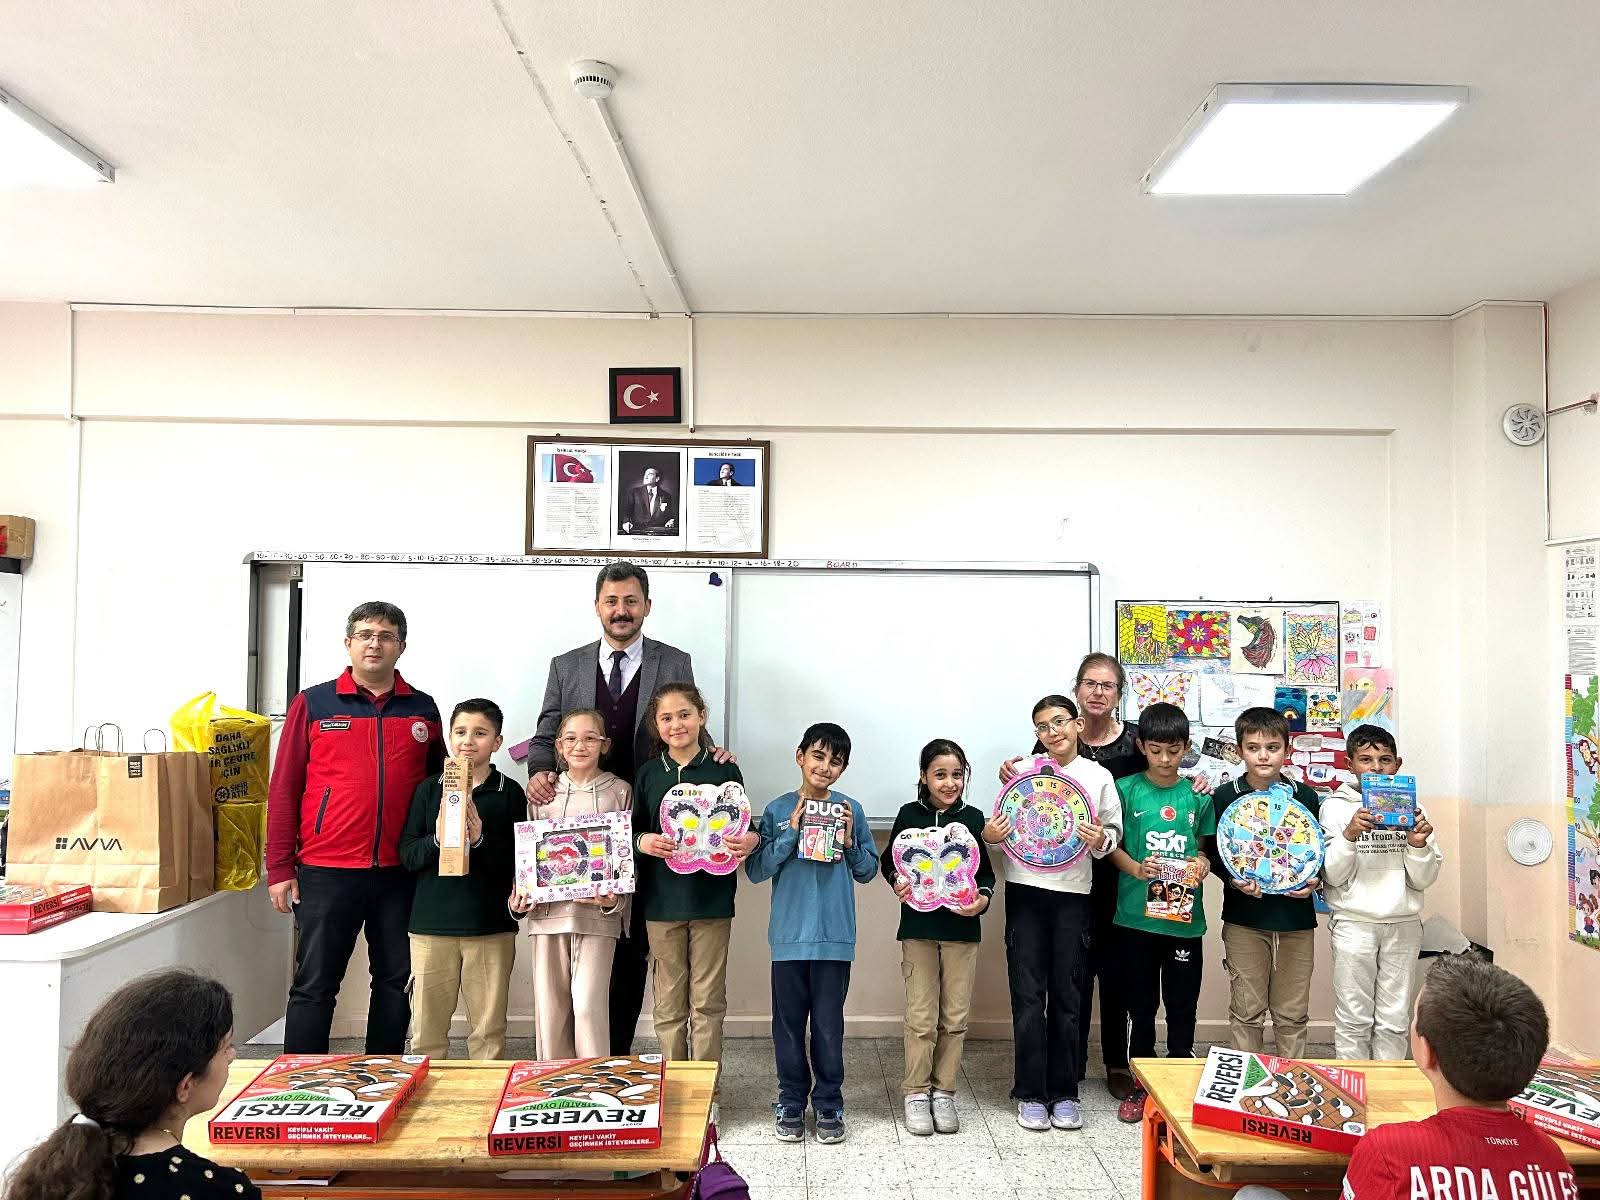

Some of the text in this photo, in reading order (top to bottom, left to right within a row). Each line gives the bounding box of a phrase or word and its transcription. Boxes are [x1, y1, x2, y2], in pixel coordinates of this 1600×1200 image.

[215, 731, 242, 743] DAHA
[1050, 781, 1057, 789] 15
[1011, 792, 1020, 802] 20
[805, 799, 845, 818] DUO
[1145, 830, 1188, 853] SIXT
[1265, 838, 1275, 846] 100
[1371, 831, 1393, 841] from
[1205, 1051, 1243, 1103] REVERSİ
[231, 1103, 375, 1120] REVERSİ
[509, 1109, 647, 1132] REVERSİ
[213, 1124, 280, 1140] REVERSİ
[568, 1133, 596, 1141] KEYİFLİ
[1241, 1117, 1312, 1144] REVERSİ
[493, 1133, 562, 1151] REVERSİ
[568, 1140, 604, 1148] GEÇİRMEK
[1484, 1135, 1519, 1147] TÜRKİYE
[1409, 1166, 1500, 1200] ARDA
